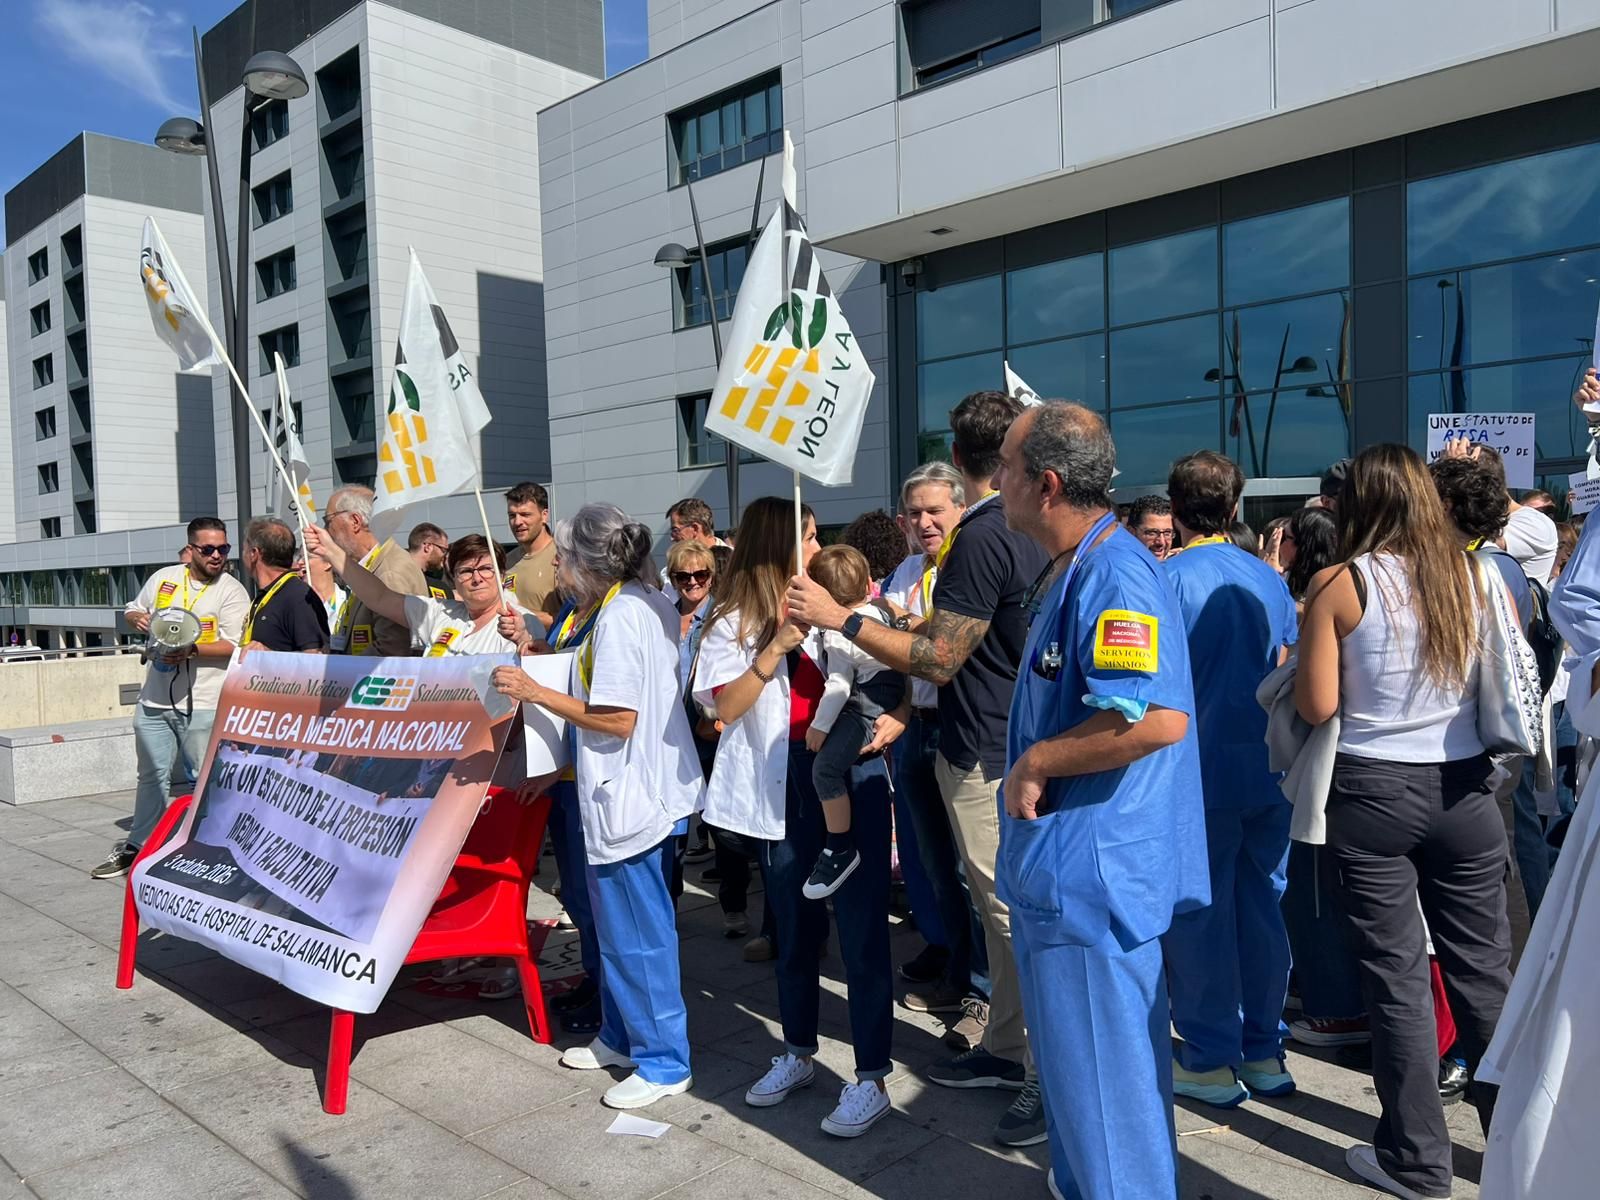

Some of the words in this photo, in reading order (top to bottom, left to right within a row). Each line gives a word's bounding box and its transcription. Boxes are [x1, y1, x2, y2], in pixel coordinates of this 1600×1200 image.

[1430, 417, 1449, 429] UN
[1453, 414, 1518, 428] ESTATUTO
[1521, 416, 1533, 424] DE
[1516, 448, 1528, 456] DE
[1100, 649, 1151, 659] SERVICIOS
[244, 675, 302, 697] Sindicato
[302, 676, 349, 698] Médico
[223, 705, 303, 742] HUELGA
[302, 710, 376, 750] MÉDICA
[373, 720, 471, 752] NACIONAL
[237, 765, 263, 794] UN
[257, 767, 314, 819] ESTATUTO
[303, 788, 331, 826] DE
[319, 797, 346, 836] LA
[338, 803, 418, 858] PROFESIÓN
[226, 807, 263, 857] MÉDICA
[248, 830, 276, 860] Y
[163, 853, 184, 867] 3
[170, 857, 211, 877] octubre
[253, 835, 340, 903] FACULTATIVA
[202, 863, 238, 884] 2025
[180, 896, 203, 923] DEL
[200, 905, 257, 942] HOSPITAL
[252, 923, 278, 948] DE
[271, 930, 376, 984] SALAMANCA
